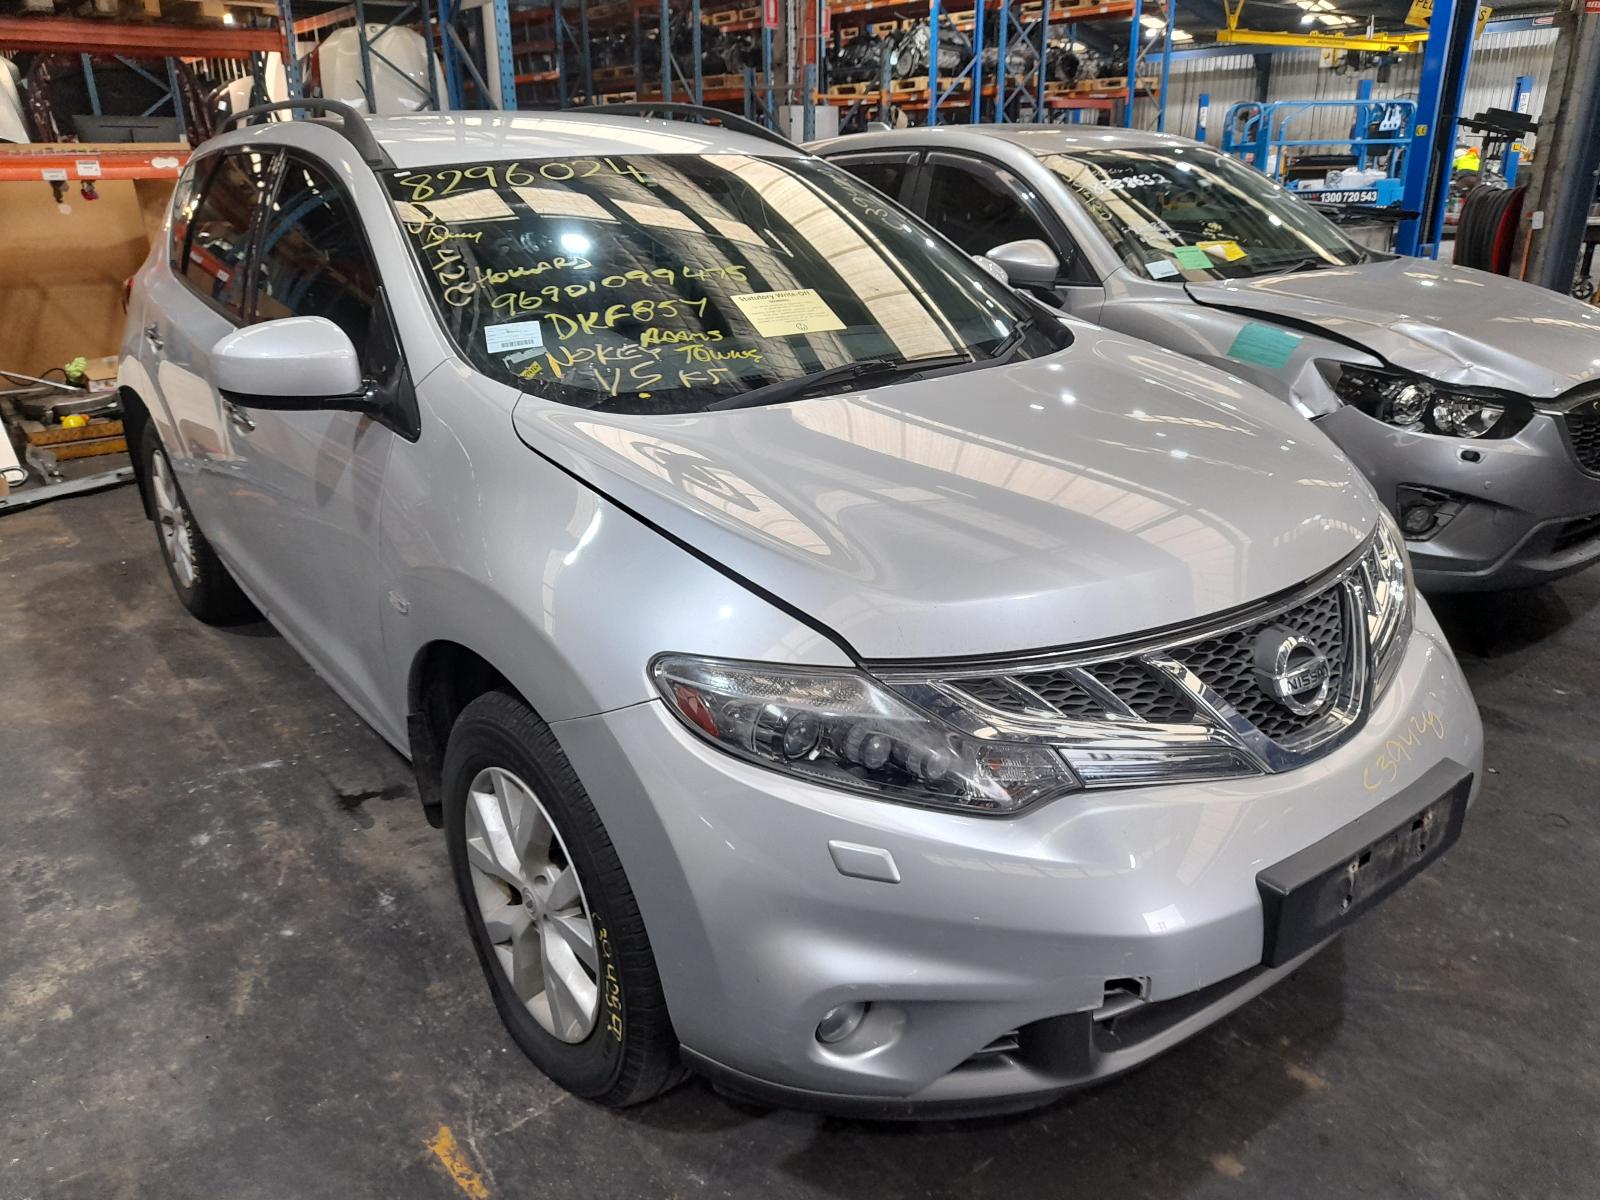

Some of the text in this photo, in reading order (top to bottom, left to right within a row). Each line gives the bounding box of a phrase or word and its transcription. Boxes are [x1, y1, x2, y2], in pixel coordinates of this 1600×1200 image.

[400, 157, 651, 201] 8296024
[1321, 191, 1342, 203] 1300
[1343, 191, 1360, 202] 720
[1360, 190, 1378, 202] 543
